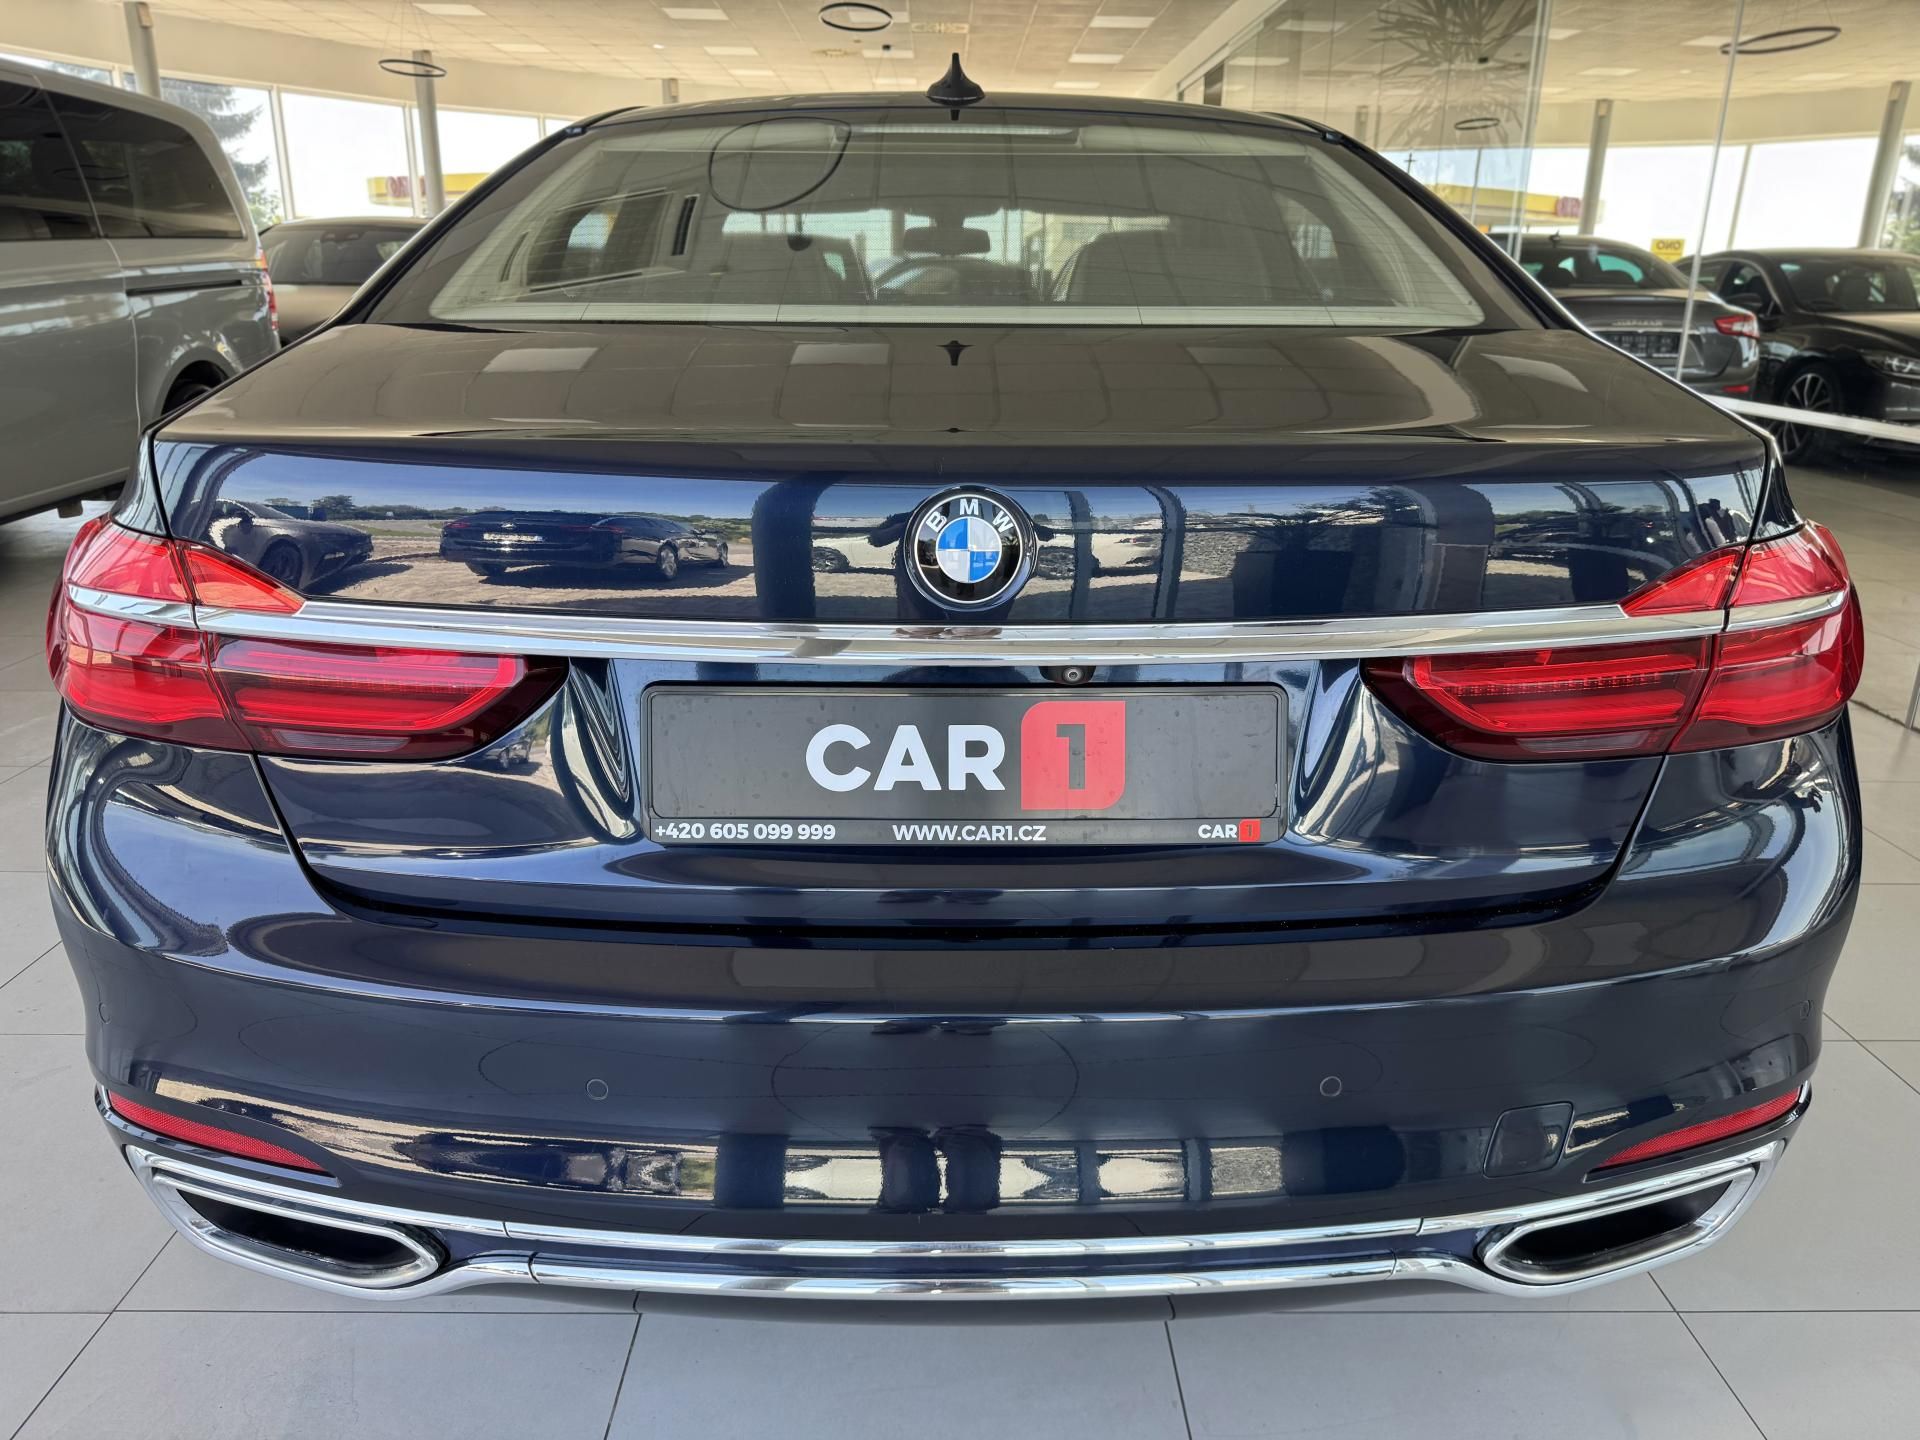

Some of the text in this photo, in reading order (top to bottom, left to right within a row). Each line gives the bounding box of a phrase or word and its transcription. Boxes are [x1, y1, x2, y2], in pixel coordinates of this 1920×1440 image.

[926, 498, 1014, 533] BMW
[655, 823, 836, 840] +420 605 099 999
[892, 824, 1047, 841] WWW.CAR1.CZ
